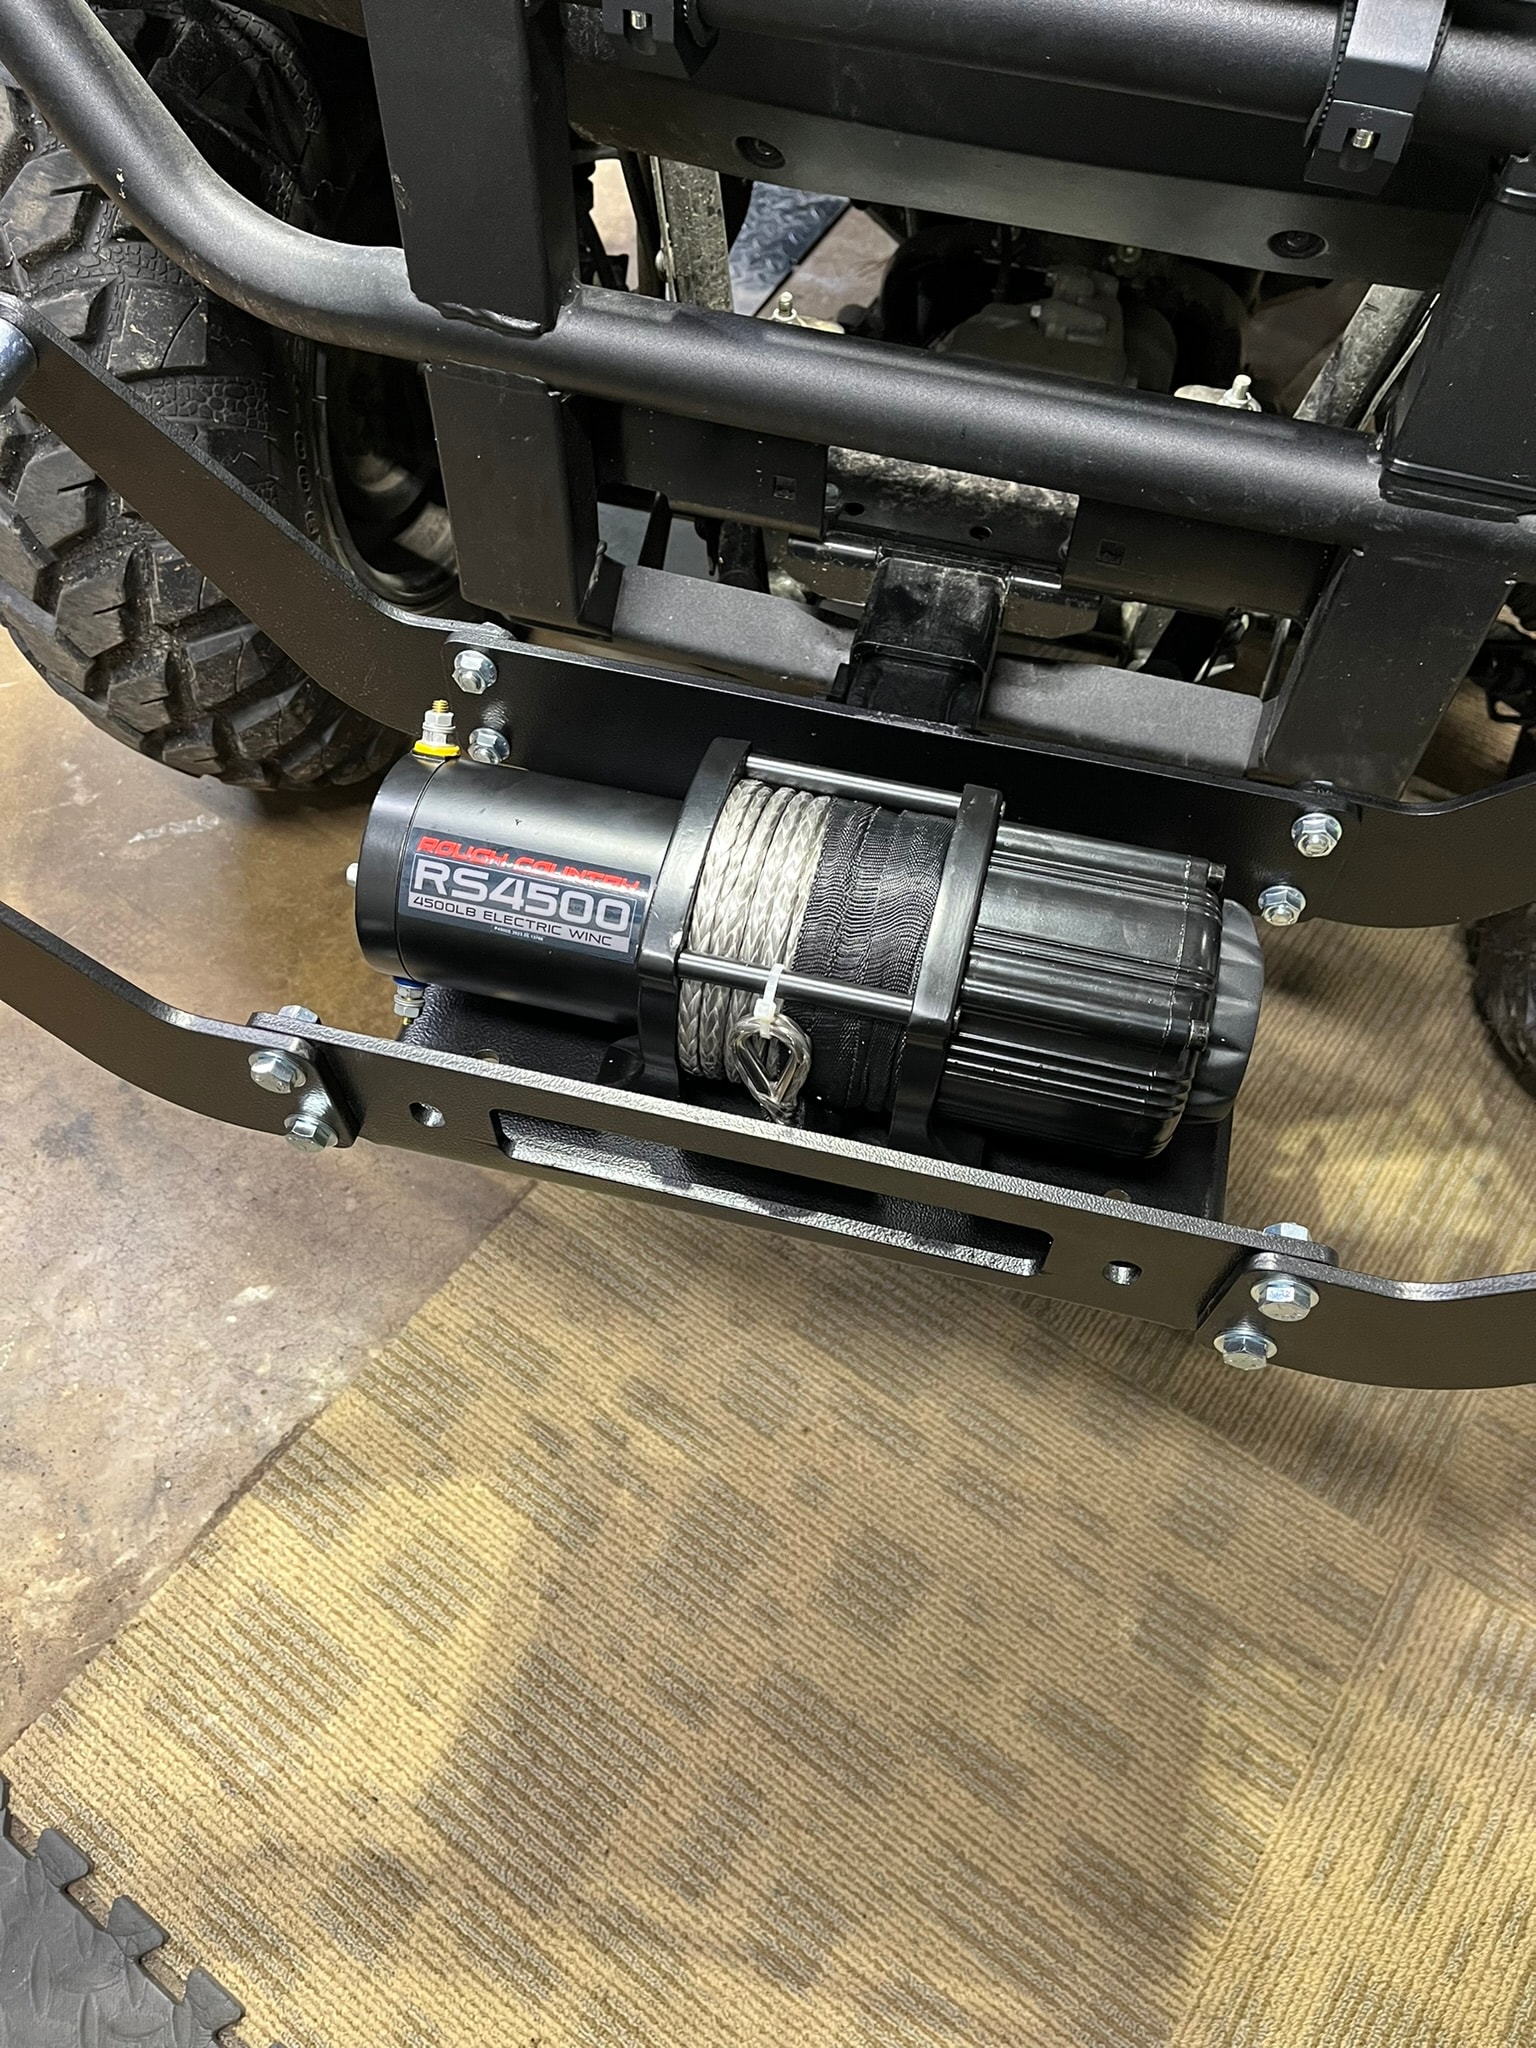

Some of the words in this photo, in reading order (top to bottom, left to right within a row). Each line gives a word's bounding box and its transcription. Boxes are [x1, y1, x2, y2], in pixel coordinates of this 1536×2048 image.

[416, 836, 510, 867] ROUGH
[513, 856, 640, 891] COUNTRY
[413, 858, 631, 932] RS4500
[413, 896, 477, 917] 4500LB
[483, 910, 562, 936] ELECTRIC
[569, 928, 613, 946] WINC
